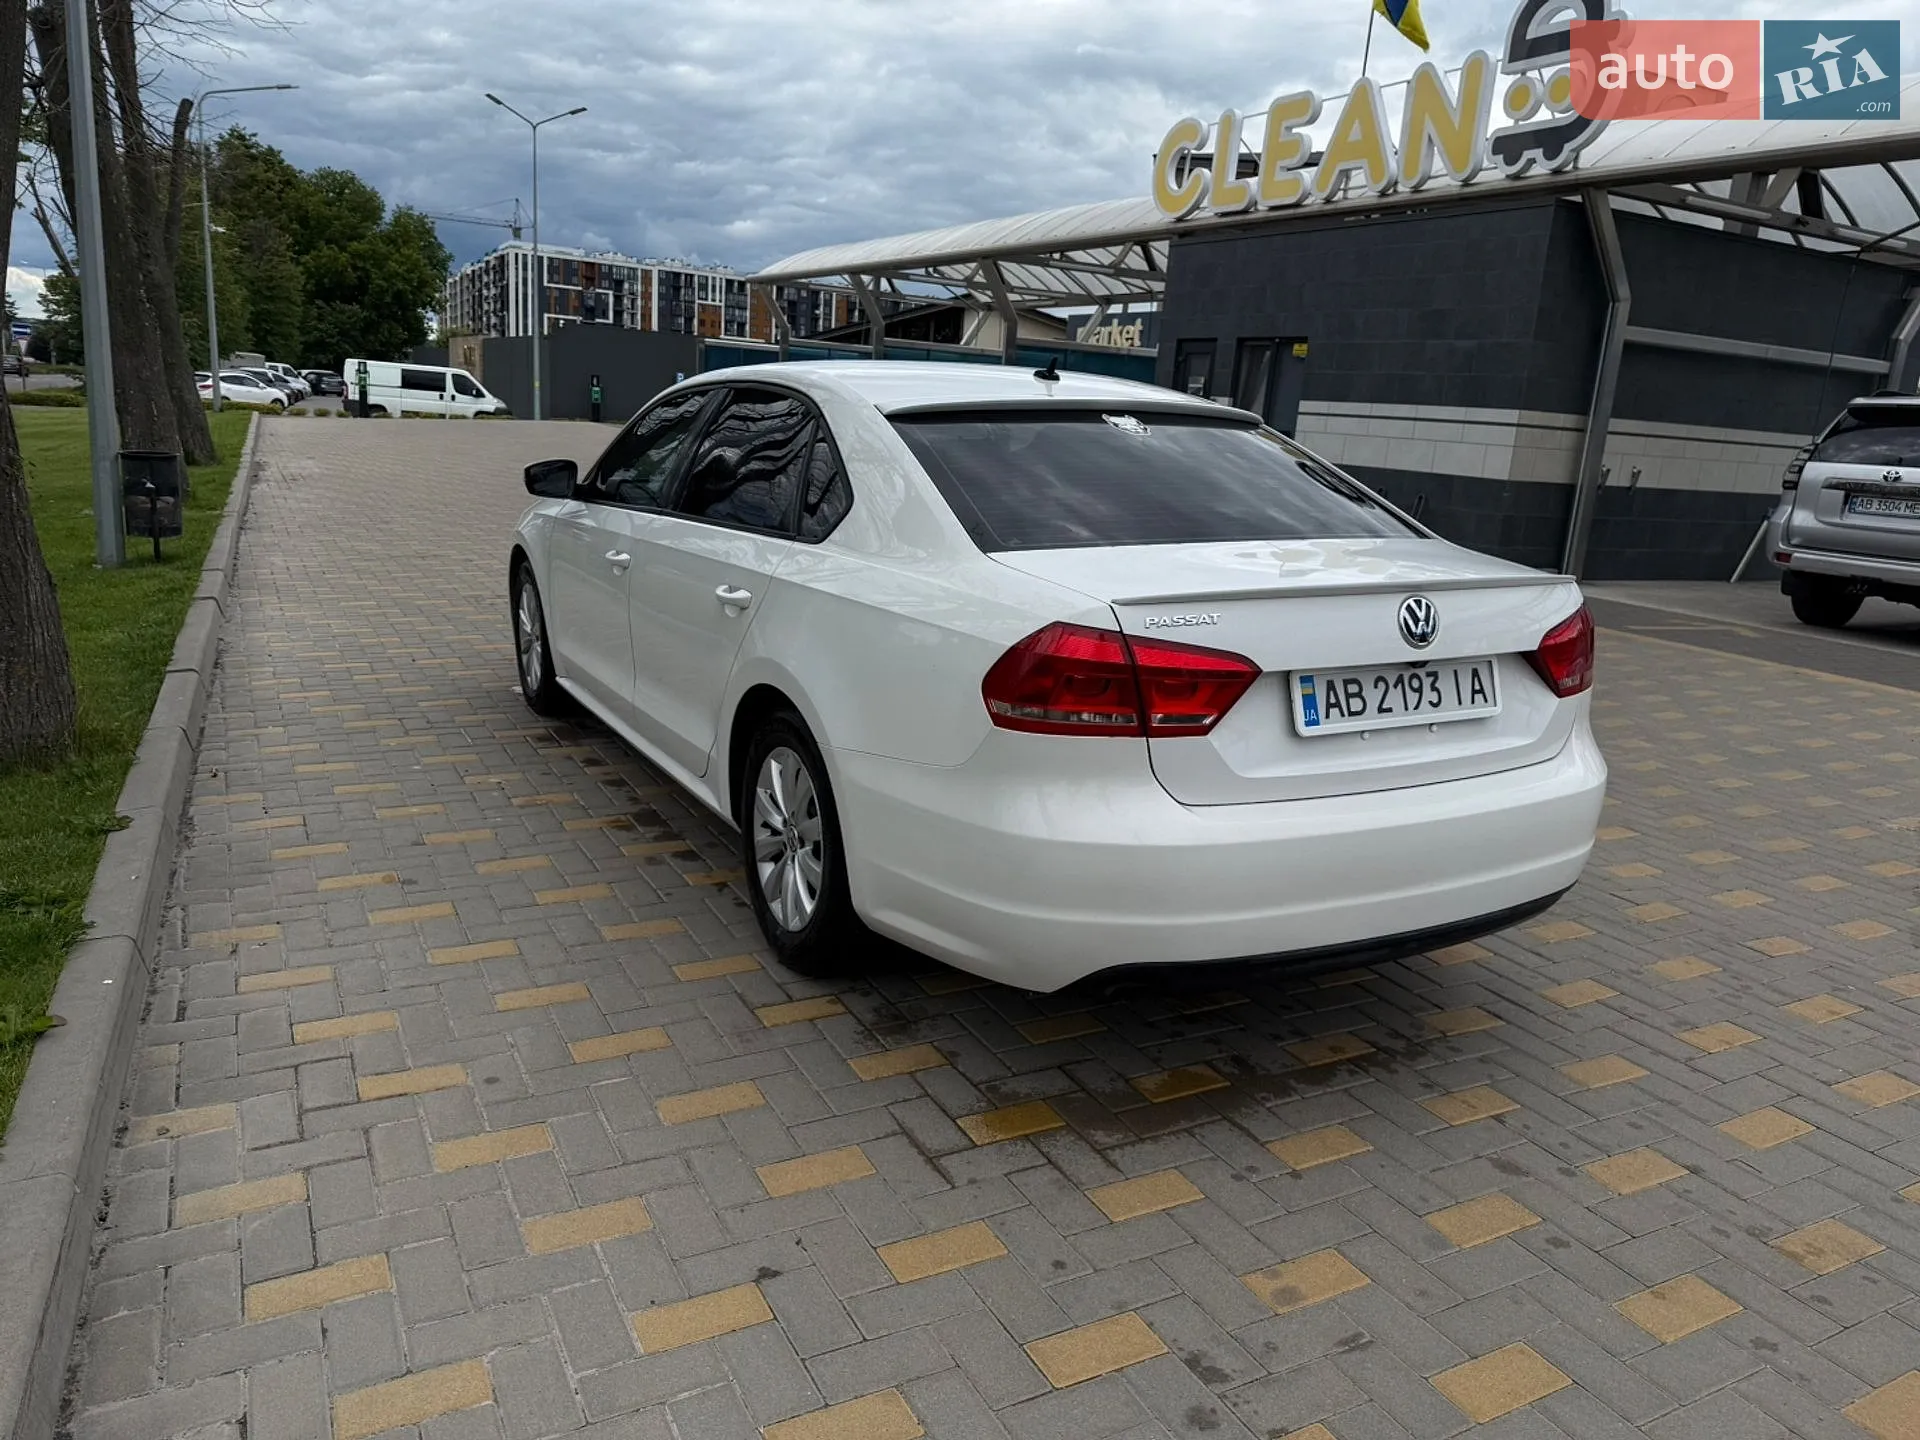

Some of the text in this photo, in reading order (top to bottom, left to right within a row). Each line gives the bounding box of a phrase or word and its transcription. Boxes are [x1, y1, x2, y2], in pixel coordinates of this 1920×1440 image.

[1151, 50, 1495, 221] CLEAN
[1857, 498, 1873, 510] AB
[1875, 500, 1902, 512] 3504
[1144, 613, 1221, 629] PASSAT
[1325, 678, 1367, 720] AB
[1373, 671, 1442, 714] 2193
